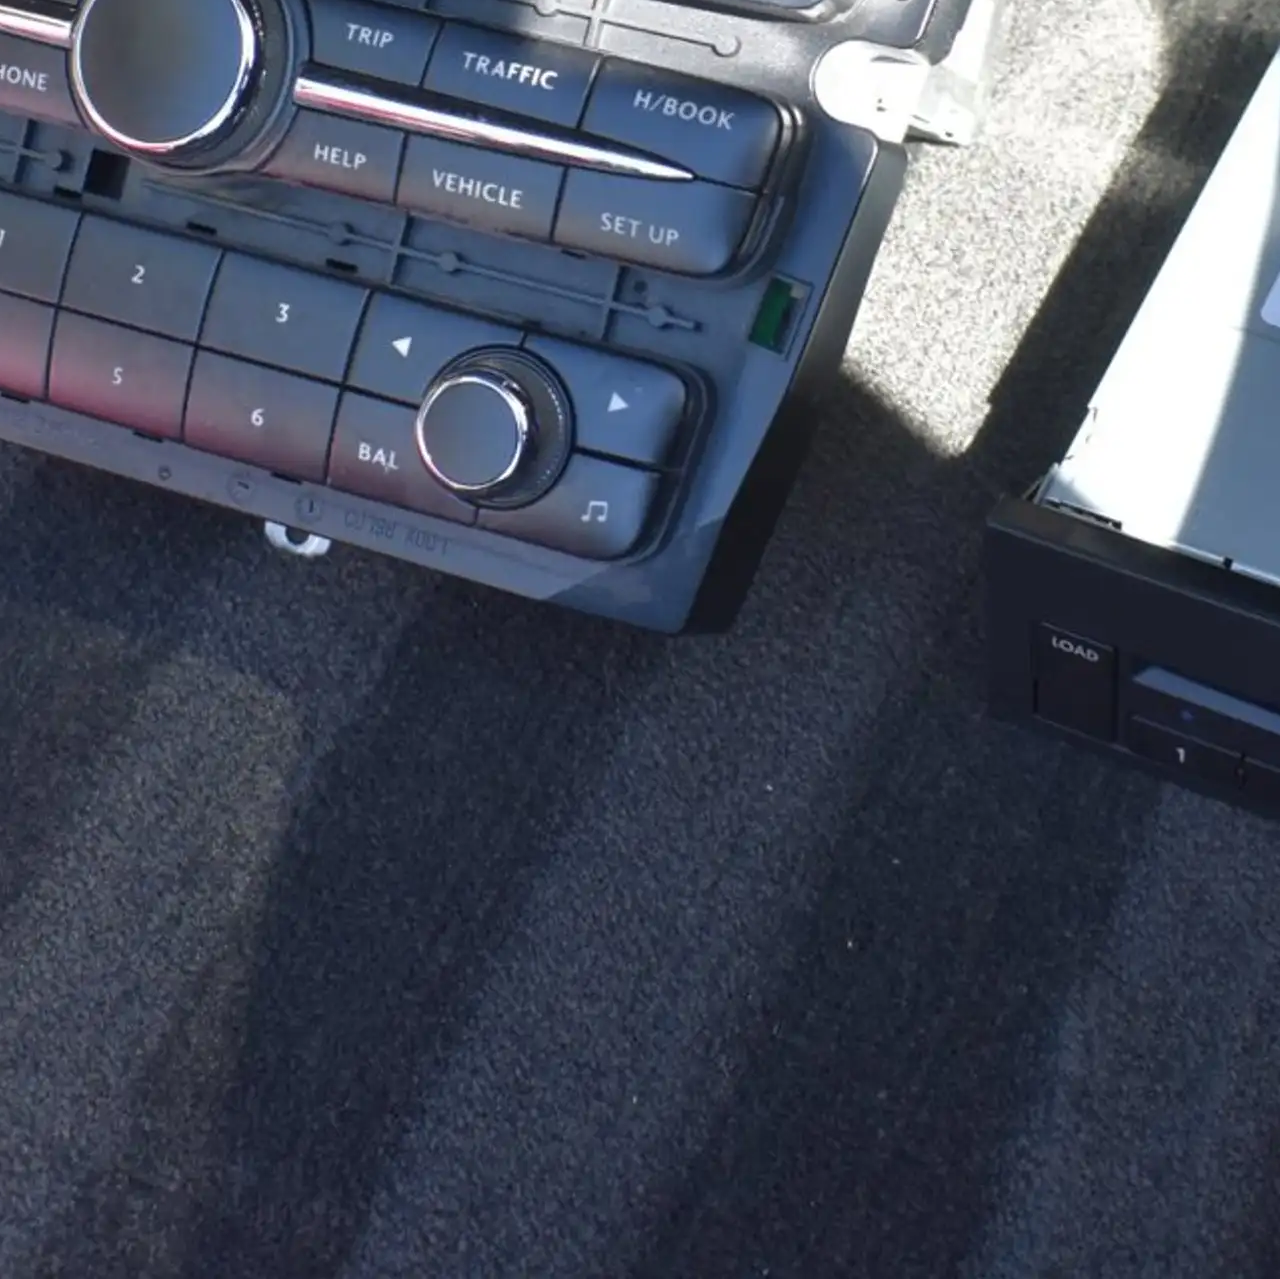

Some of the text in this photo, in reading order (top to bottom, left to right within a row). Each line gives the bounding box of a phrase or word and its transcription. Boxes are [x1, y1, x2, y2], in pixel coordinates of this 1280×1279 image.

[348, 23, 393, 48] TRIP
[464, 53, 558, 90] TRAFFIC
[633, 90, 734, 131] H/BOOK
[314, 144, 367, 169] HELP
[433, 169, 523, 209] VEHICLE
[600, 212, 680, 246] SET UP
[131, 265, 145, 284] 2
[276, 303, 290, 323] 3
[112, 367, 123, 385] 5
[251, 408, 264, 427] 6
[358, 442, 397, 470] BAL
[1051, 636, 1099, 662] LOAD
[1176, 747, 1186, 763] 1
